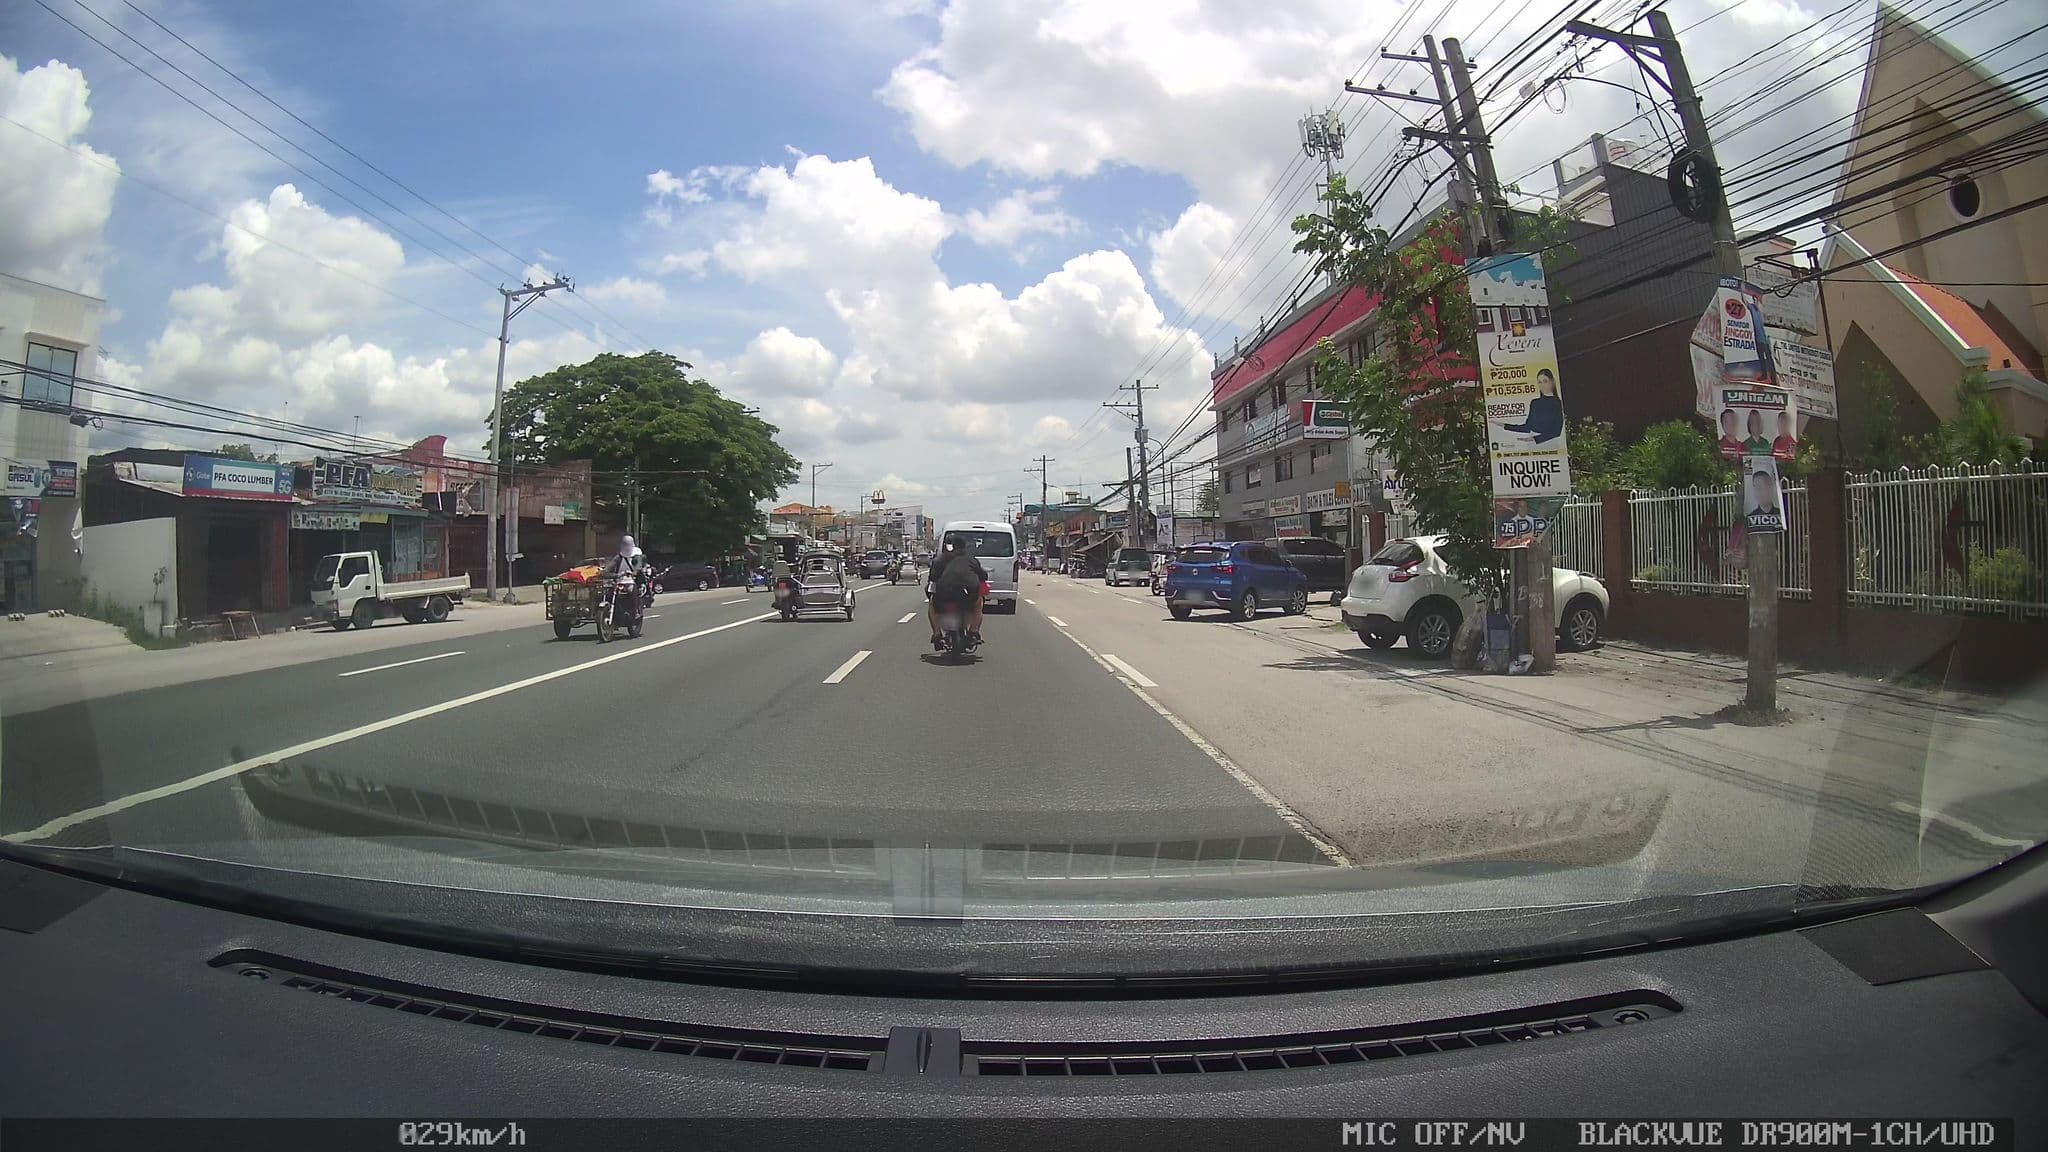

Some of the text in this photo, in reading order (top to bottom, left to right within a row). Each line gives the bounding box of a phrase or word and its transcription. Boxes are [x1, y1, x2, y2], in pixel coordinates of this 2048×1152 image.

[1727, 319, 1749, 328] SENATOR
[1724, 327, 1752, 339] JINGGOY
[1724, 337, 1755, 351] ESTRADA
[1488, 402, 1525, 411] READY FOR
[1488, 408, 1526, 416] OCCUPANCY
[1499, 460, 1560, 475] INQUIRE
[8, 473, 34, 483] GASUL
[214, 472, 273, 485] PFA COCO LUMBER
[325, 462, 370, 488] PFA
[279, 480, 292, 494] 5G
[1511, 474, 1551, 489] NOW!
[1749, 516, 1777, 526] VICO
